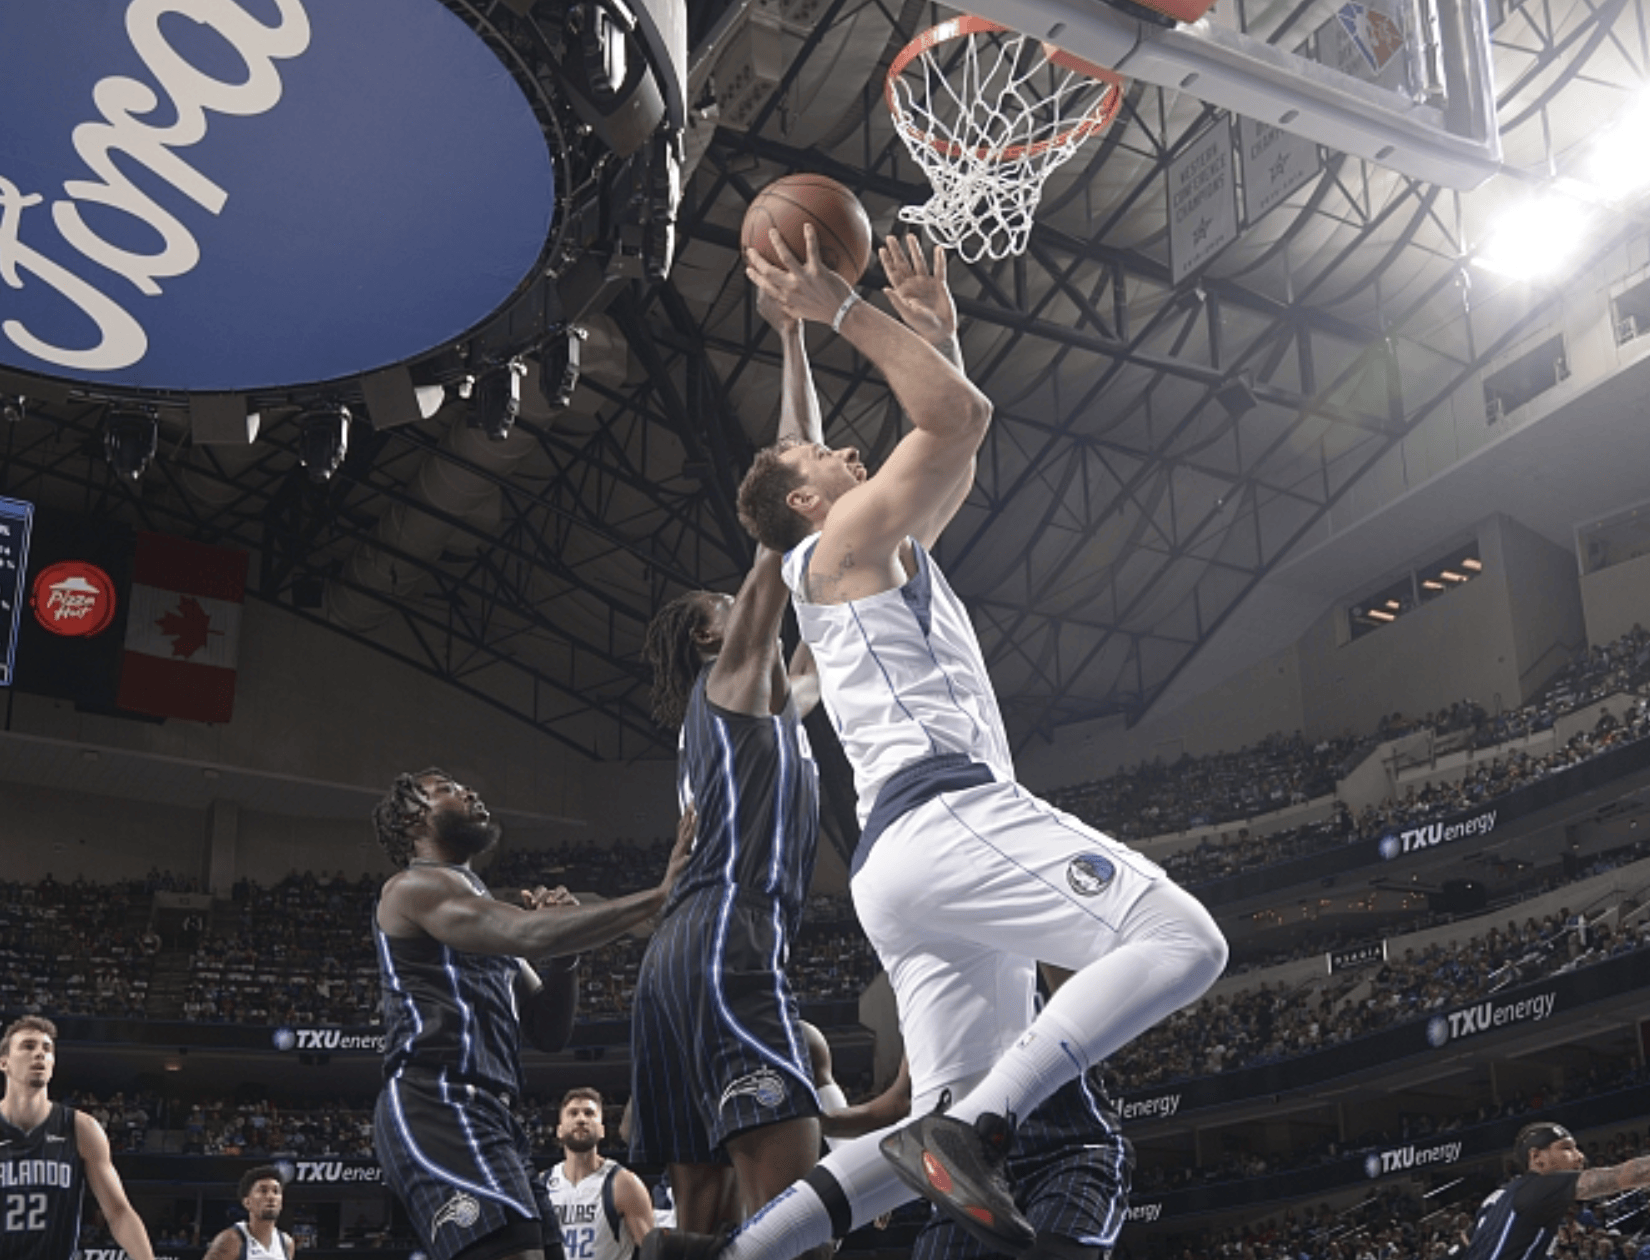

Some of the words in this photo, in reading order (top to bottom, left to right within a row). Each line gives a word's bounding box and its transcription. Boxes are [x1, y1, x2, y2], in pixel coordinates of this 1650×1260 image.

[341, 1034, 387, 1053] energ
[0, 1160, 71, 1188] LANDO
[6, 1193, 47, 1231] 22
[563, 1228, 595, 1258] 42
